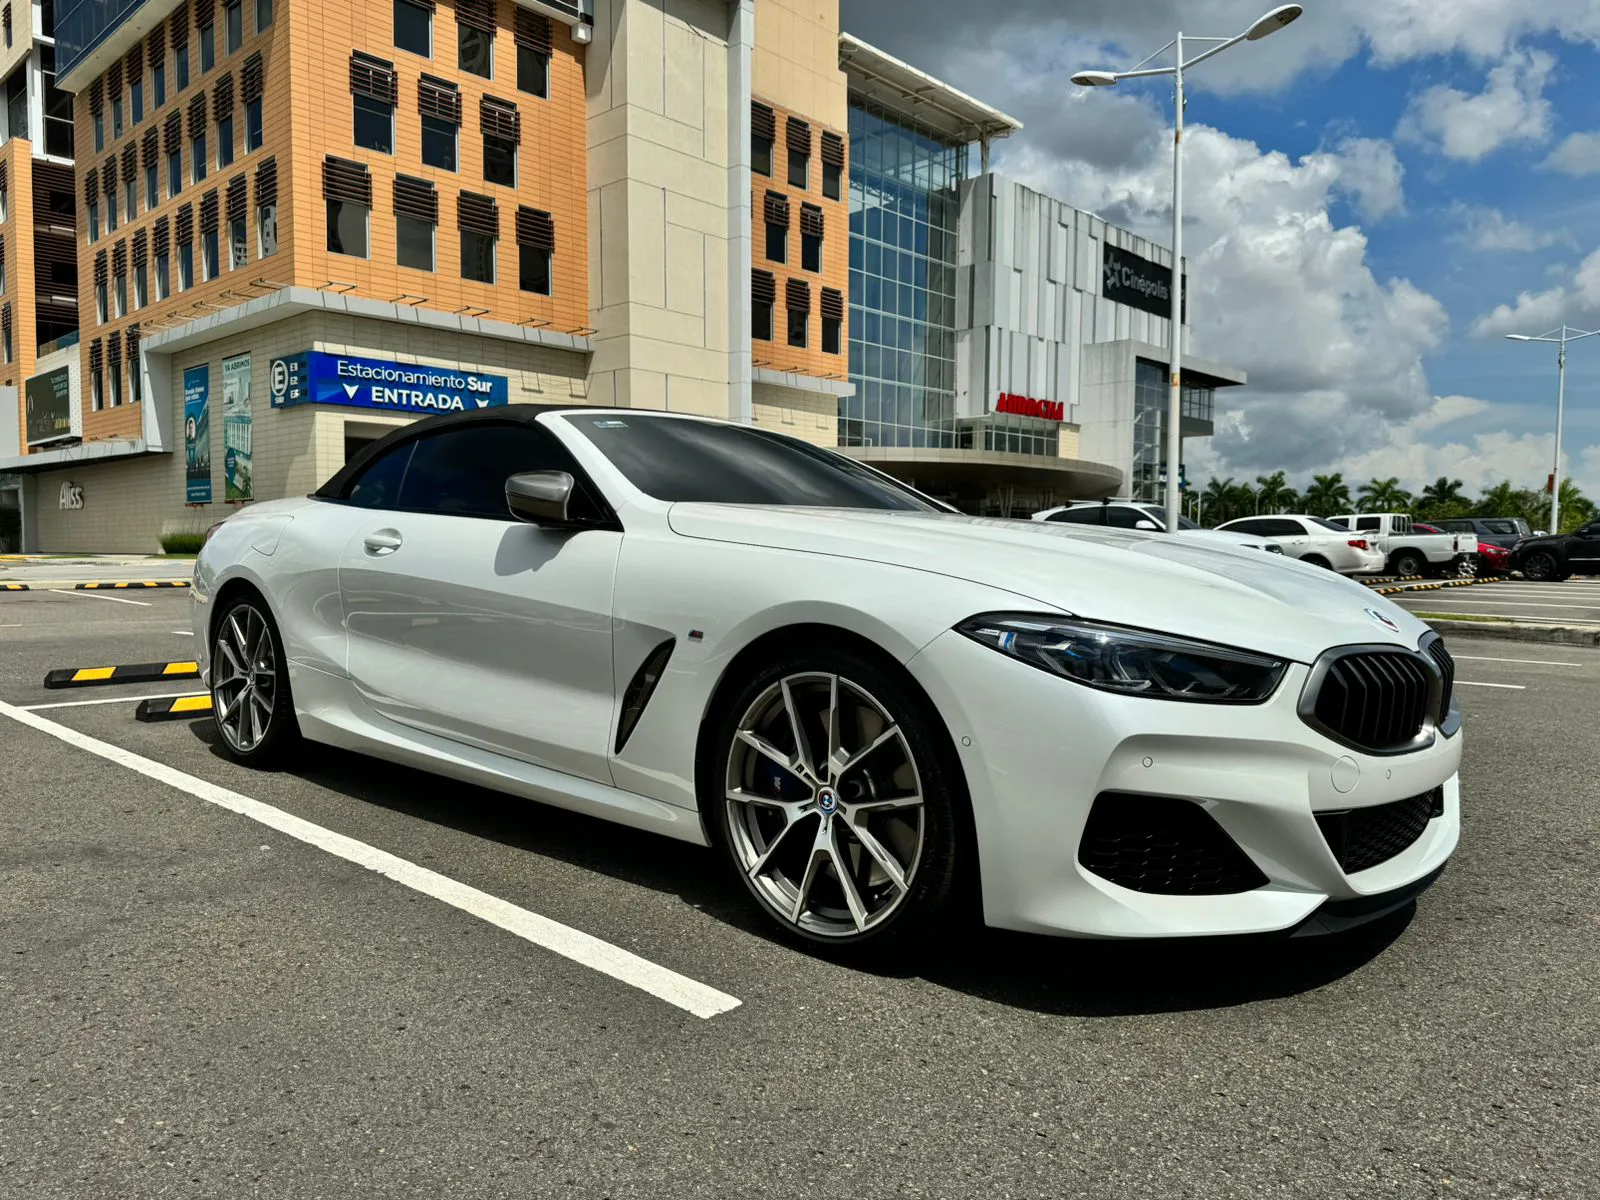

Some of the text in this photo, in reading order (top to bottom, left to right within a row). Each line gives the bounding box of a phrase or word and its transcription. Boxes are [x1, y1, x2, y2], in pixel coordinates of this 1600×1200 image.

[1122, 266, 1168, 300] Cinépolis
[231, 359, 250, 370] ABRIMOS
[275, 366, 284, 390] E
[337, 360, 493, 393] Estacionamiento Sur
[371, 386, 465, 411] ENTRADA
[60, 480, 84, 510] Aliss
